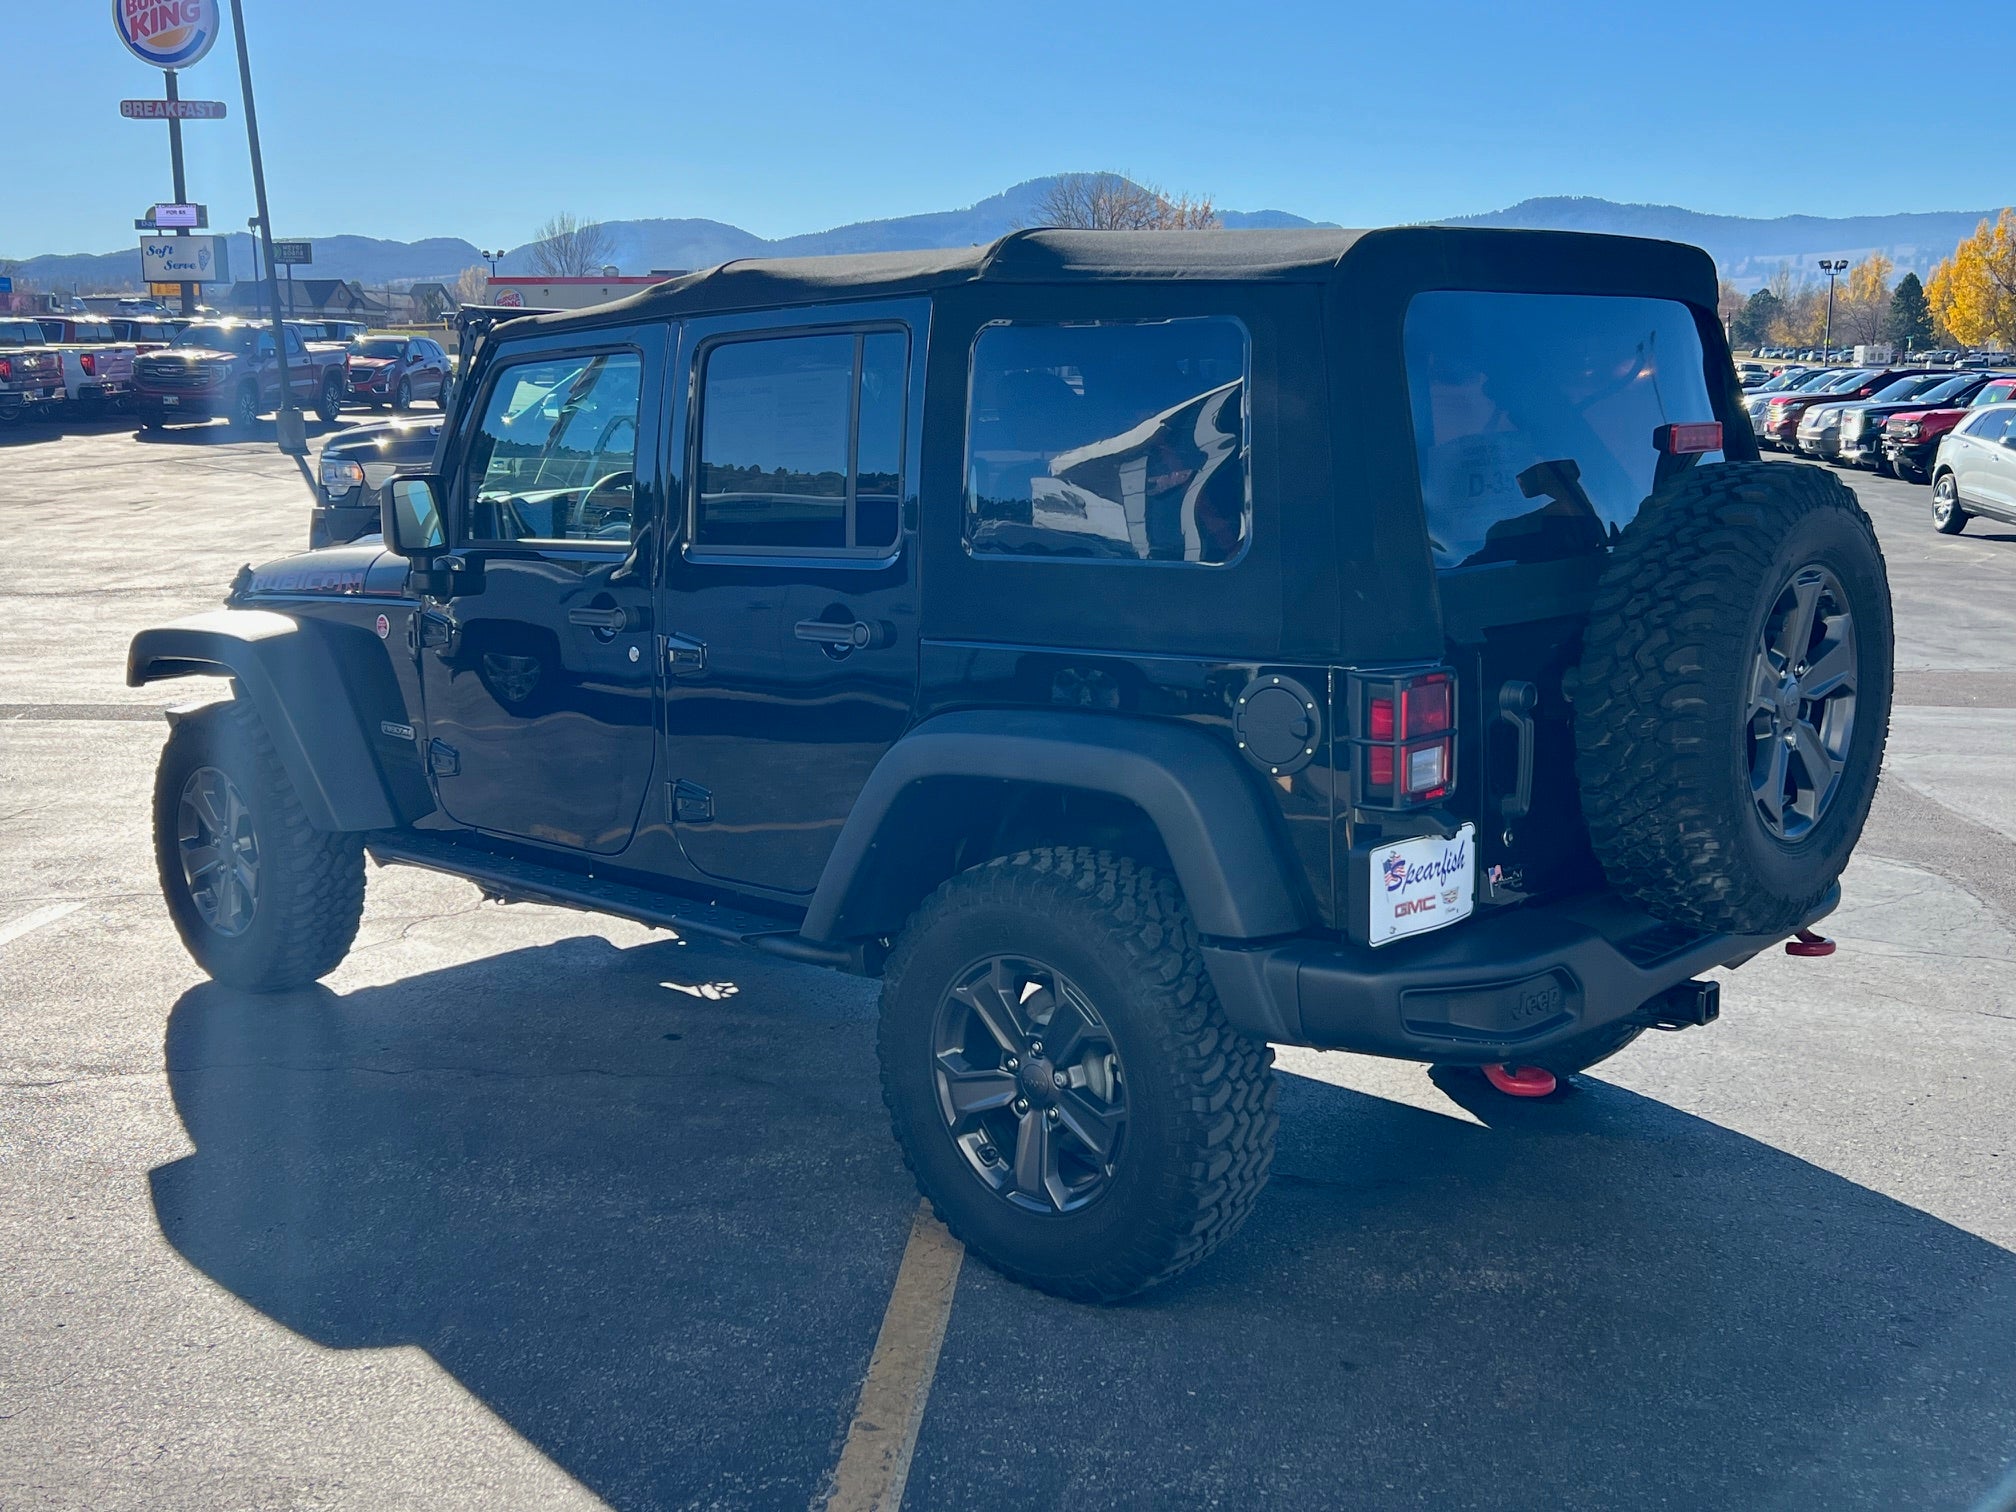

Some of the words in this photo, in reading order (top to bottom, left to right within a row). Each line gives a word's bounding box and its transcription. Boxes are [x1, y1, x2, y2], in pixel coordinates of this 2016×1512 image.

[130, 0, 201, 42] KING
[121, 101, 216, 117] BREAKFAST
[146, 244, 174, 258] Soft
[164, 260, 197, 271] Serve
[250, 572, 363, 592] RUBICON
[1387, 840, 1466, 895] Spearfish
[1394, 895, 1436, 918] GMC
[1512, 986, 1560, 1020] Jeep
